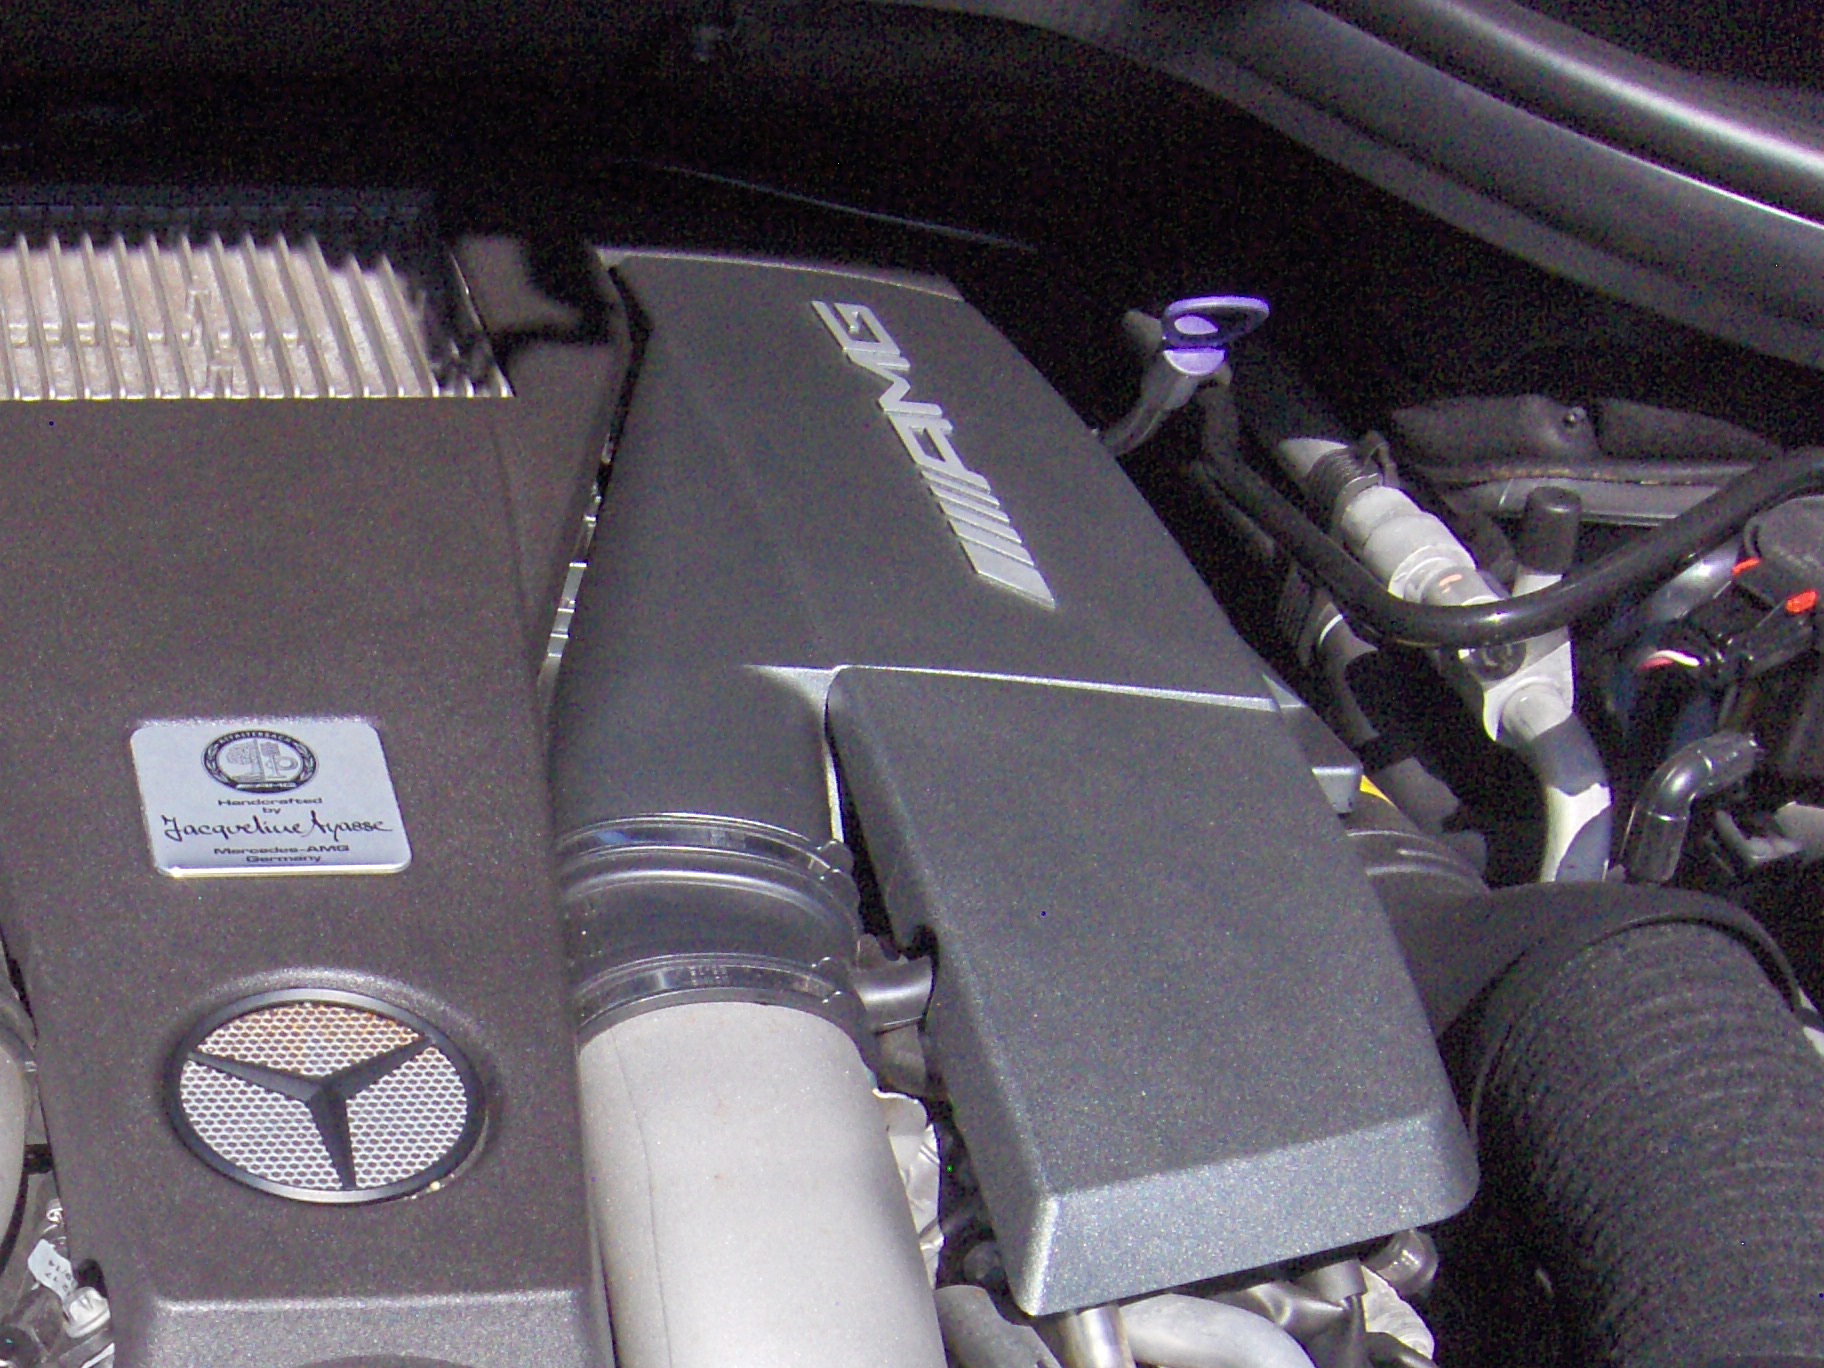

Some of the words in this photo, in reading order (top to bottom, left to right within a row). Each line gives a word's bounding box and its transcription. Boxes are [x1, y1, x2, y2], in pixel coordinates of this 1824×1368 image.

[218, 797, 323, 806] Handcrafted
[262, 806, 282, 814] by
[214, 845, 350, 855] Mercedes-AMG
[246, 855, 321, 863] Germany
